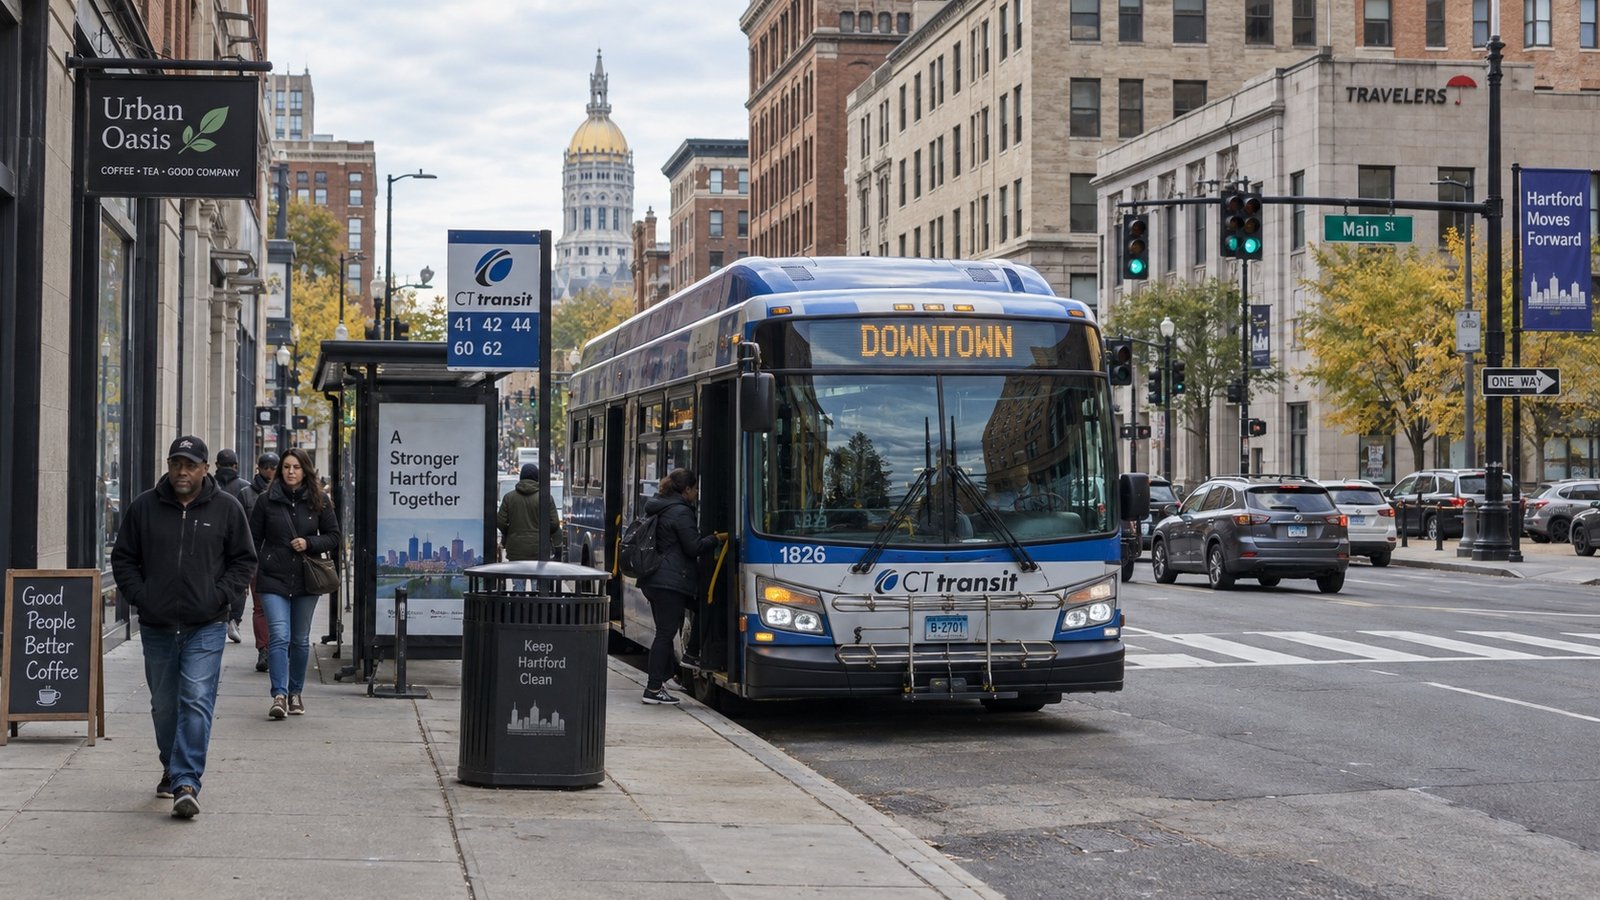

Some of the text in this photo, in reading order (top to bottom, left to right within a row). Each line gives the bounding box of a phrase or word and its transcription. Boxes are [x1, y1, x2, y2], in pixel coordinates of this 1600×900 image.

[1346, 86, 1447, 105] TRAVELERS
[102, 97, 184, 121] Urban
[101, 126, 171, 150] Oasis
[101, 166, 240, 177] COFFEE TEA GOOD COMPANY
[1527, 191, 1583, 207] Hartford
[1527, 211, 1570, 227] Moves
[1343, 221, 1395, 238] Main St
[1527, 231, 1582, 247] Forward
[454, 291, 533, 306] CT transit
[454, 317, 532, 332] 41 42 44
[454, 341, 503, 356] 60 62
[860, 324, 1014, 358] DOWNTOWN
[1491, 376, 1544, 387] ONE WAY
[390, 429, 402, 445] A
[390, 450, 460, 469] Stronger
[390, 470, 458, 486] Hartford
[389, 491, 461, 510] Together
[779, 546, 826, 564] 1826
[903, 569, 1018, 593] CT transit
[22, 585, 64, 606] Good
[26, 610, 76, 634] People
[24, 636, 74, 656] Better
[524, 639, 554, 655] Keep
[26, 660, 79, 681] Coffee
[518, 656, 566, 671] Hartford
[519, 672, 553, 685] Clean
